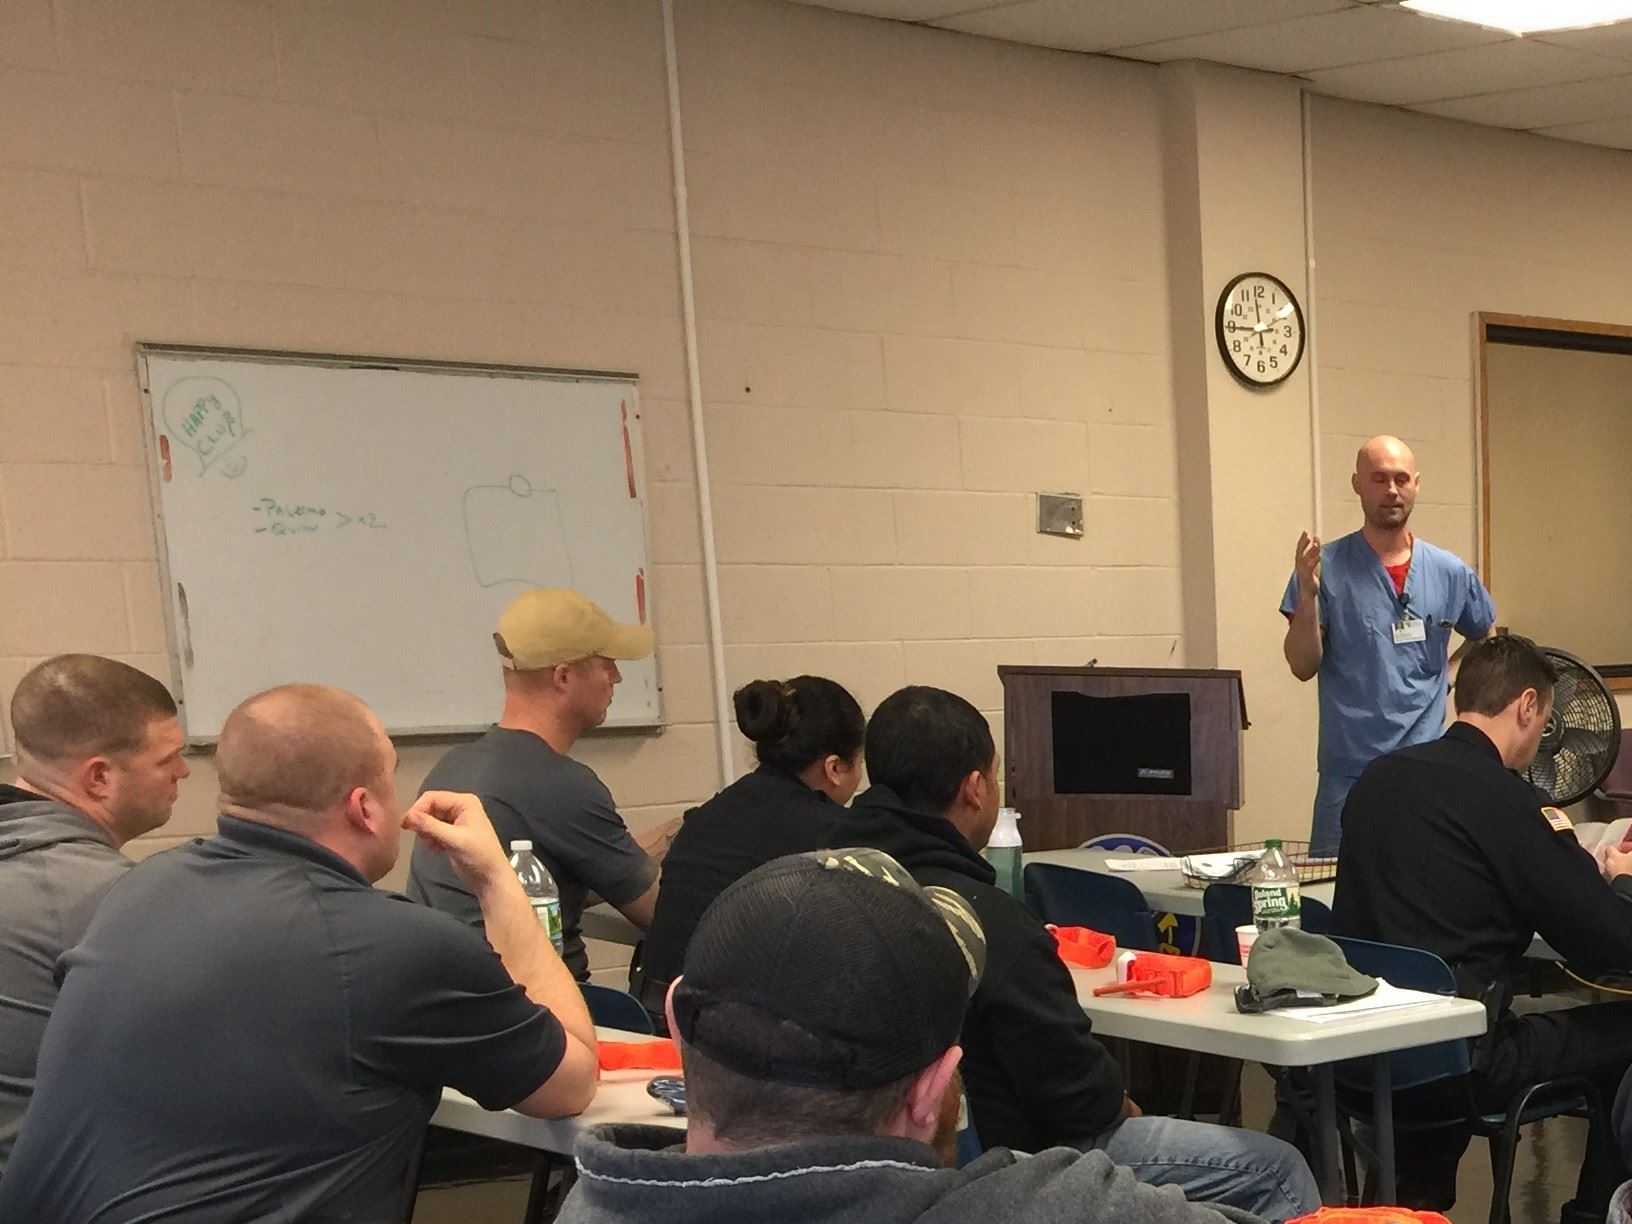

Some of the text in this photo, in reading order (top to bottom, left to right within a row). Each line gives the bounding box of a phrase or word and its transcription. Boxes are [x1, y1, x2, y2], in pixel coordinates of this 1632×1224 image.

[1241, 289, 1250, 302] 11
[1253, 285, 1265, 298] 12
[1227, 320, 1236, 333] 9
[1283, 325, 1292, 338] 3
[1232, 339, 1242, 353] 8
[1279, 344, 1288, 356] 4
[1243, 354, 1251, 366] 7
[1256, 360, 1266, 373] 6
[1269, 355, 1278, 368] 5
